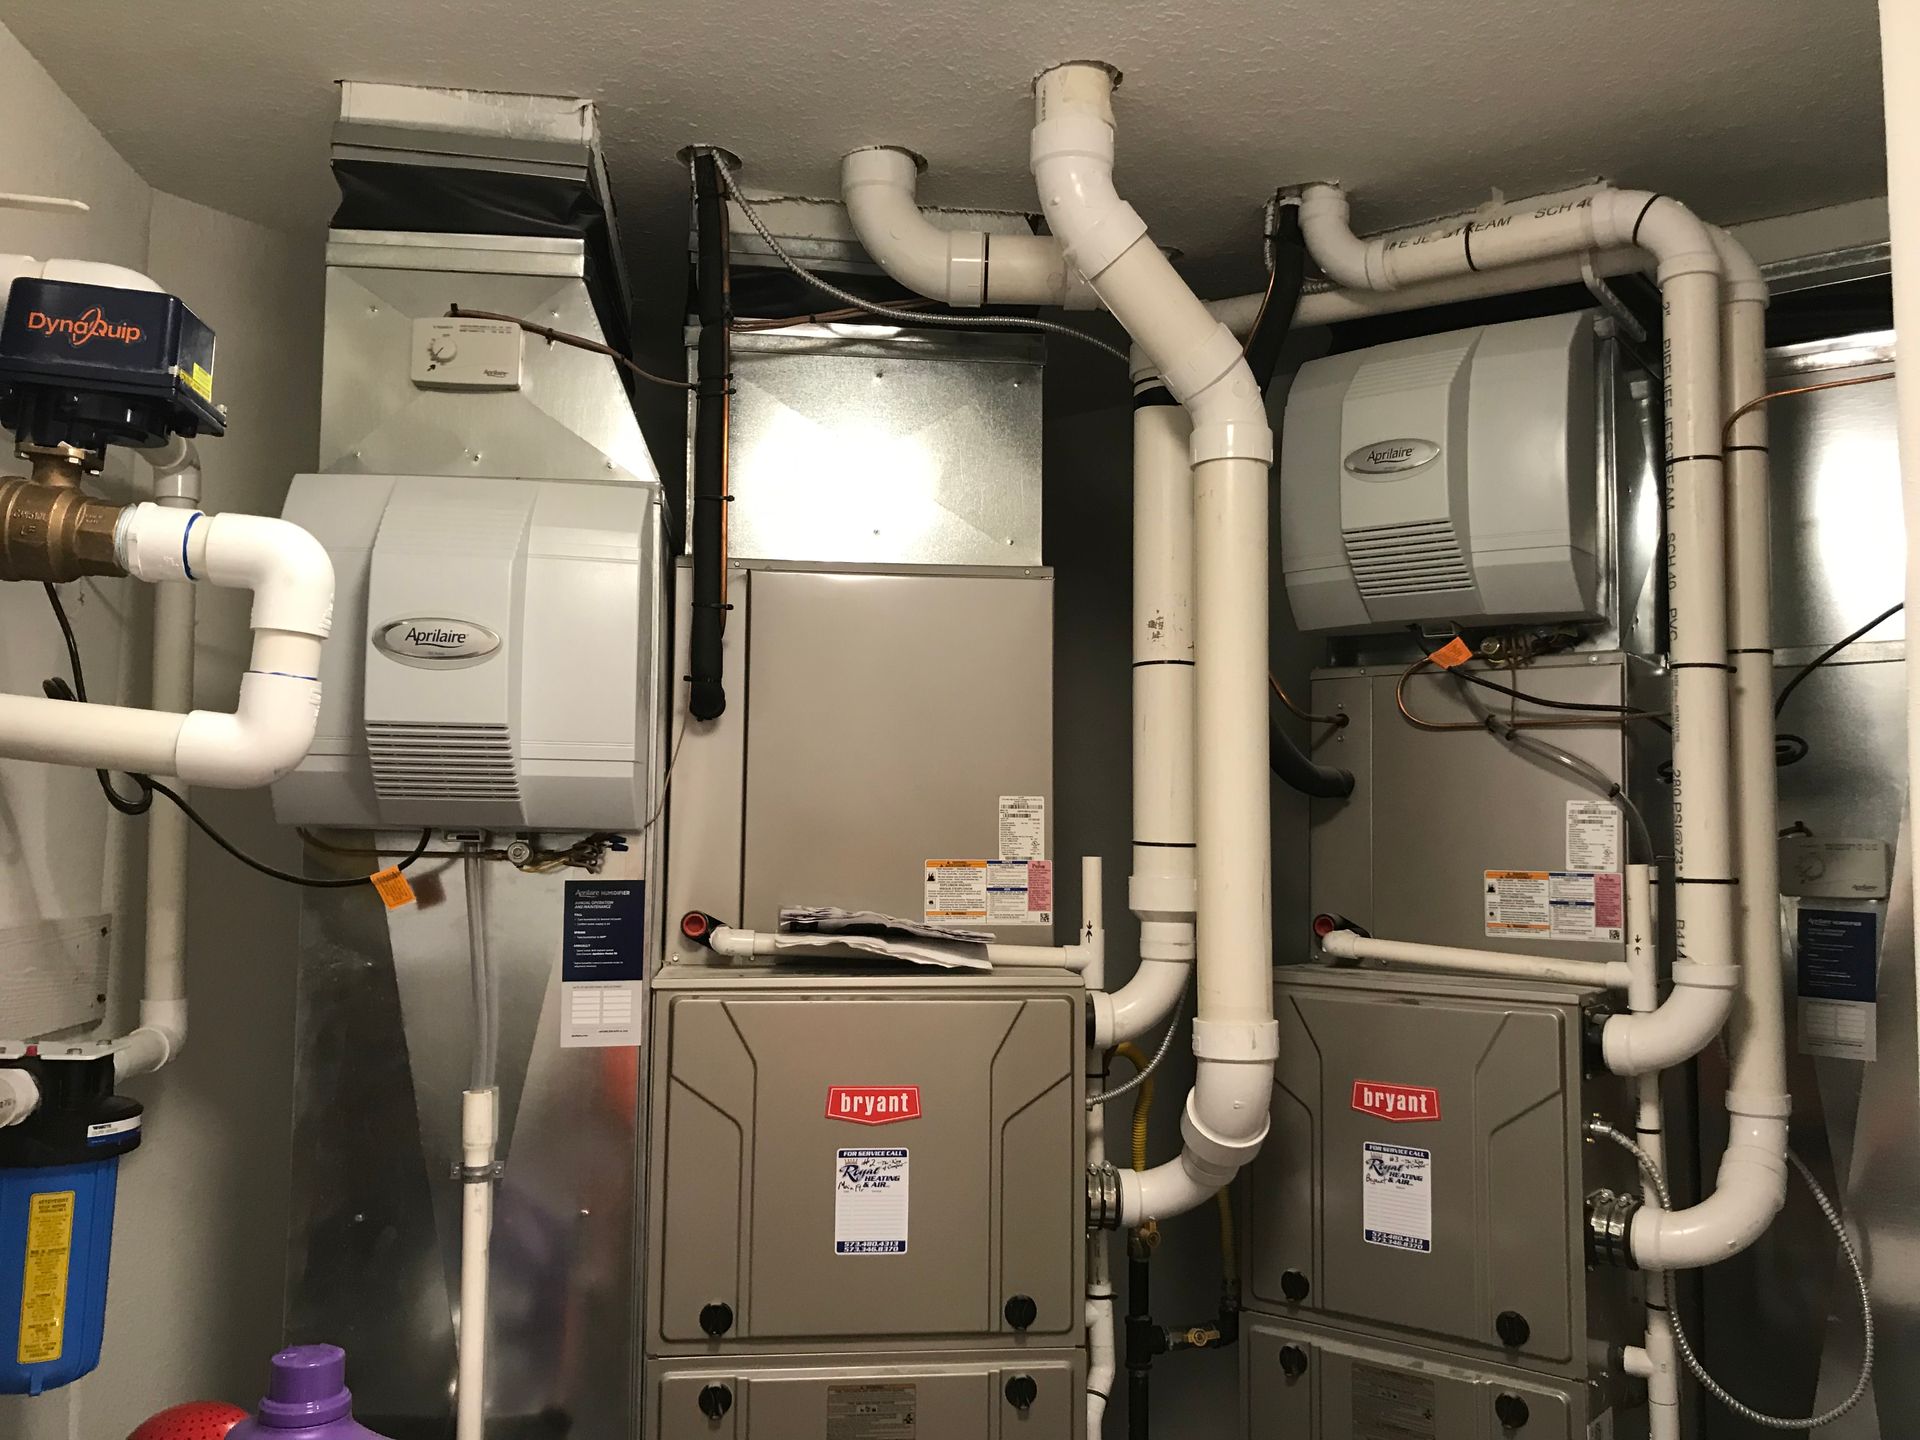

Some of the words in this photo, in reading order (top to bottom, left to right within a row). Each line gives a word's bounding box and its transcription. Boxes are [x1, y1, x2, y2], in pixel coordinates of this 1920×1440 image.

[1534, 202, 1573, 218] SCH
[28, 307, 141, 345] DynaQuip
[1367, 446, 1413, 465] Aprilaire
[405, 627, 467, 649] Aprilaire
[840, 1092, 908, 1116] bryant
[1363, 1087, 1428, 1113] bryant
[1408, 1150, 1425, 1158] CALL
[839, 1164, 881, 1182] Royal
[1366, 1158, 1404, 1177] Royal
[1388, 1171, 1424, 1182] HEATING
